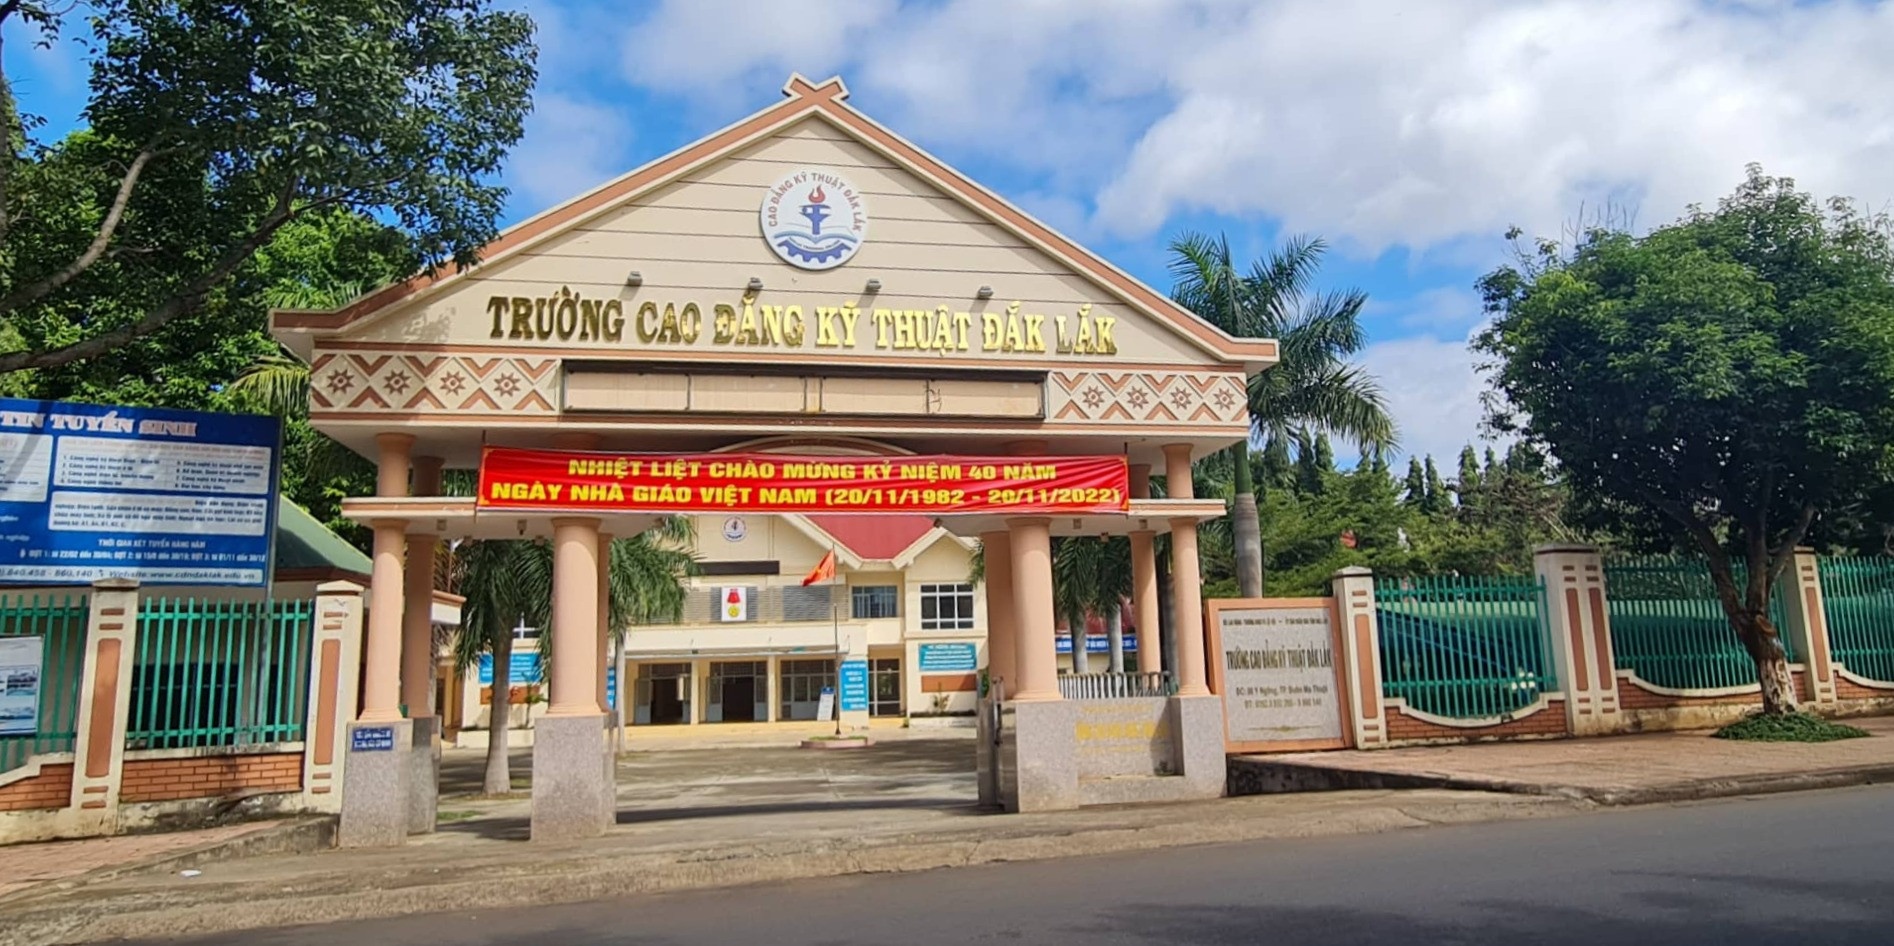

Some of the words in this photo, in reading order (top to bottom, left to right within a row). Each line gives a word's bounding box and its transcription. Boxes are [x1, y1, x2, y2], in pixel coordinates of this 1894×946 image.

[486, 285, 625, 342] TRƯỜNG
[636, 301, 702, 345] CAO
[713, 294, 805, 347] ĐẲNG
[815, 300, 861, 349] KỸ
[871, 304, 972, 357] THUẬT
[981, 300, 1047, 353] ĐẮK
[1055, 303, 1118, 354] LẮK
[0, 410, 45, 428] TIN
[138, 419, 197, 437] SINH
[568, 457, 644, 479] NHIỆT
[650, 458, 702, 481] LIỆT
[709, 459, 775, 479] CHÀO
[782, 461, 856, 480] MỪNG
[863, 459, 893, 480] KỶ
[900, 463, 962, 484] NIỆM
[968, 465, 997, 480] 40
[1003, 462, 1057, 480] NĂM
[491, 480, 563, 501] NGÀY
[570, 482, 625, 502] NHÀ
[632, 484, 692, 503] GIÁO
[700, 484, 752, 506] VIỆT
[758, 487, 817, 505] NAM
[825, 487, 965, 505] (20/11/1982
[988, 488, 1121, 505] 20/11/2022)
